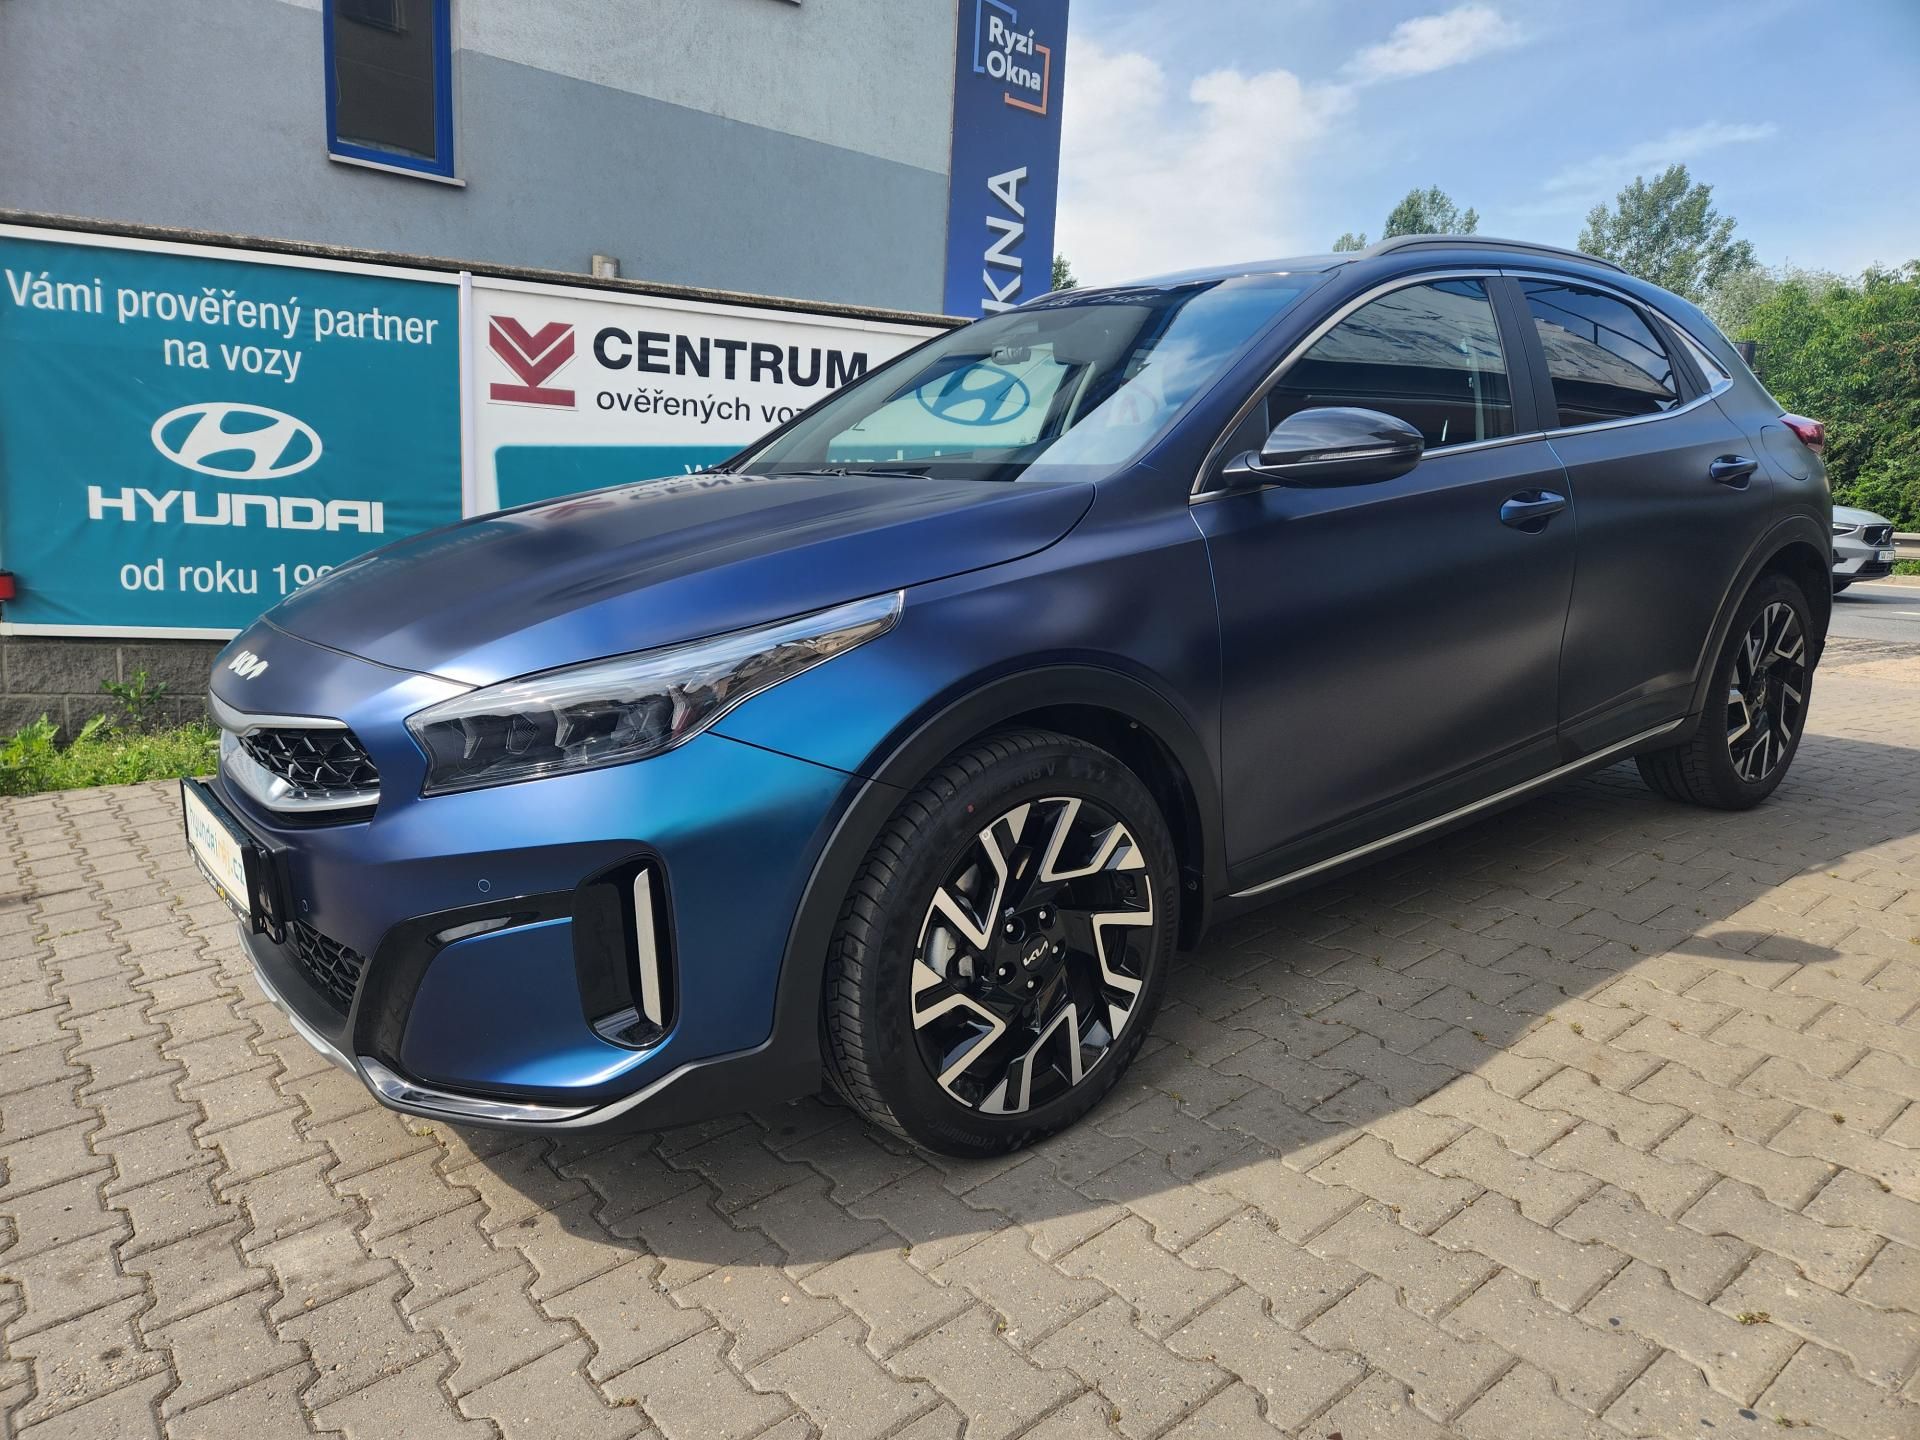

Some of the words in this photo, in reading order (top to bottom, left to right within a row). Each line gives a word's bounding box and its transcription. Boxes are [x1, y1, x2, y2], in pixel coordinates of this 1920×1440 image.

[988, 15, 1035, 56] Ryzí
[986, 50, 1041, 91] Okna
[5, 268, 103, 314] Vámi
[117, 287, 302, 339] prověřený
[314, 307, 439, 345] partner
[164, 338, 210, 369] na
[220, 343, 302, 384] vozy
[593, 326, 868, 389] CENTRUM
[596, 387, 751, 424] ověřených
[87, 485, 384, 534] HYUNDAI
[120, 557, 165, 591] od
[179, 560, 258, 594] roku
